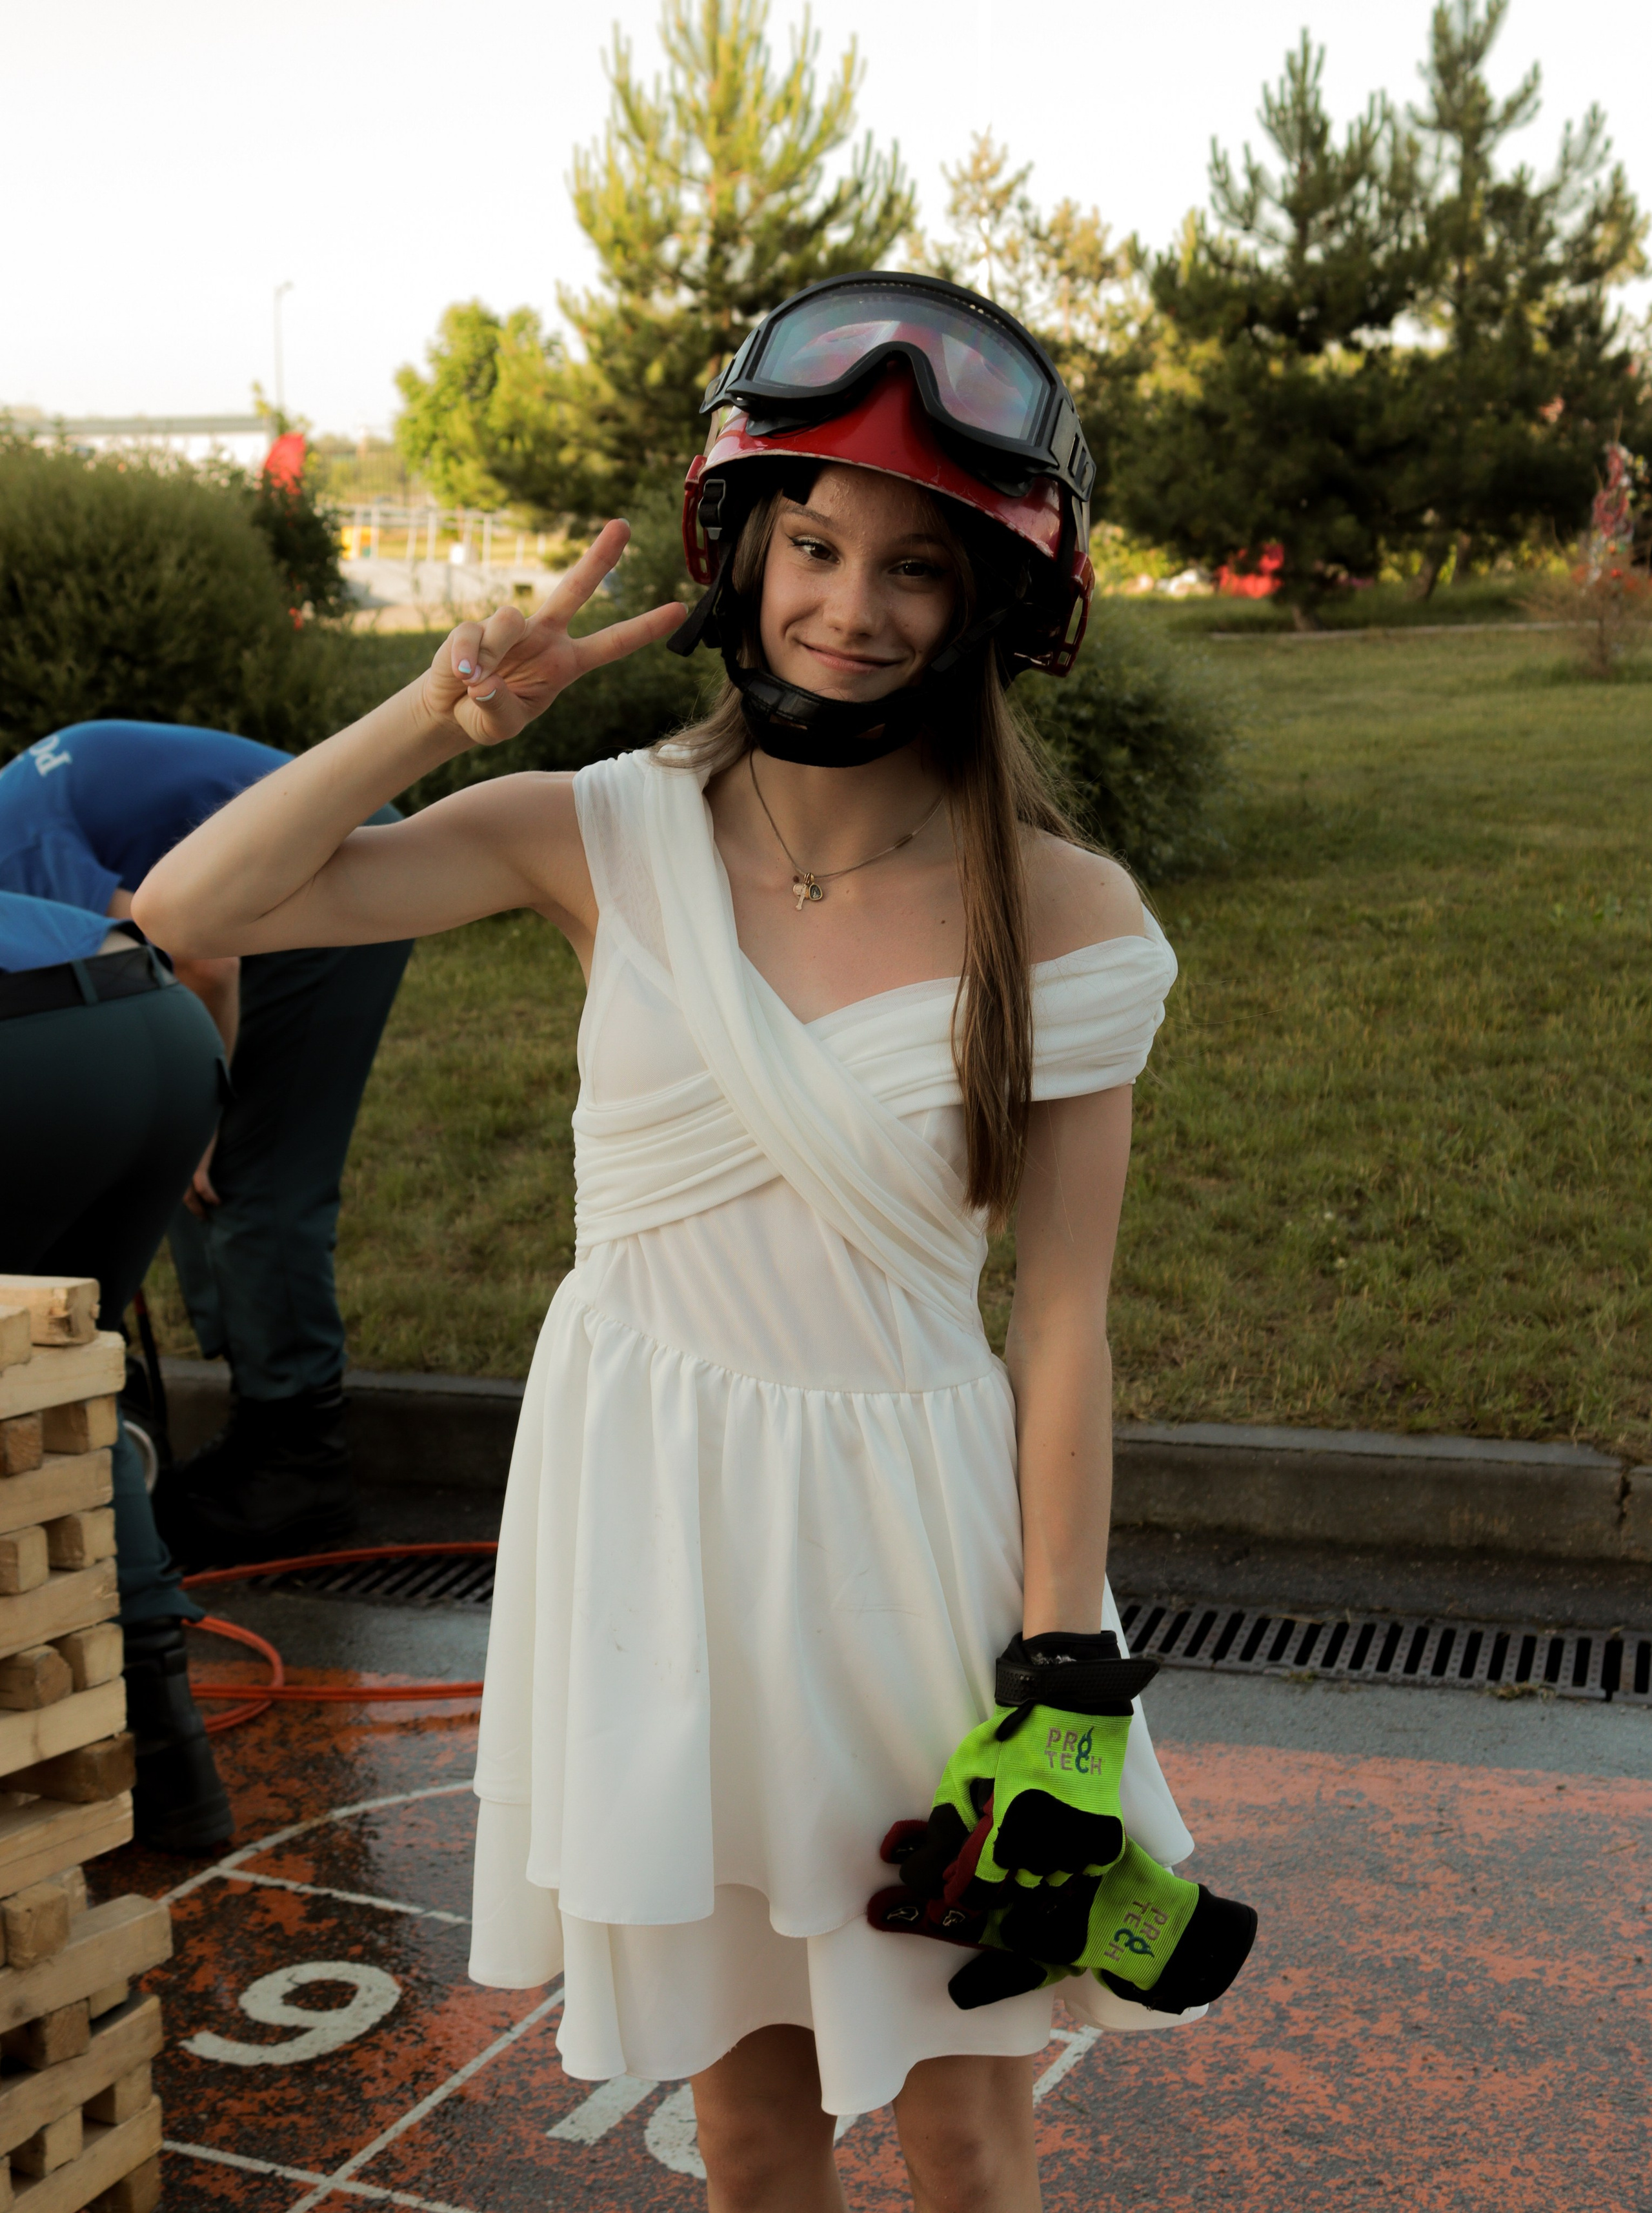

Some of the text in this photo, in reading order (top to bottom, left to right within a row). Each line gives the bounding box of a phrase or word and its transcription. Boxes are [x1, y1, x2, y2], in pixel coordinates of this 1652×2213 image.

[1044, 1750, 1102, 1776] TECH
[1046, 1726, 1095, 1758] PRO
[1103, 1900, 1151, 1963] TECH
[1129, 1906, 1170, 1958] PRO
[179, 1960, 402, 2065] 9
